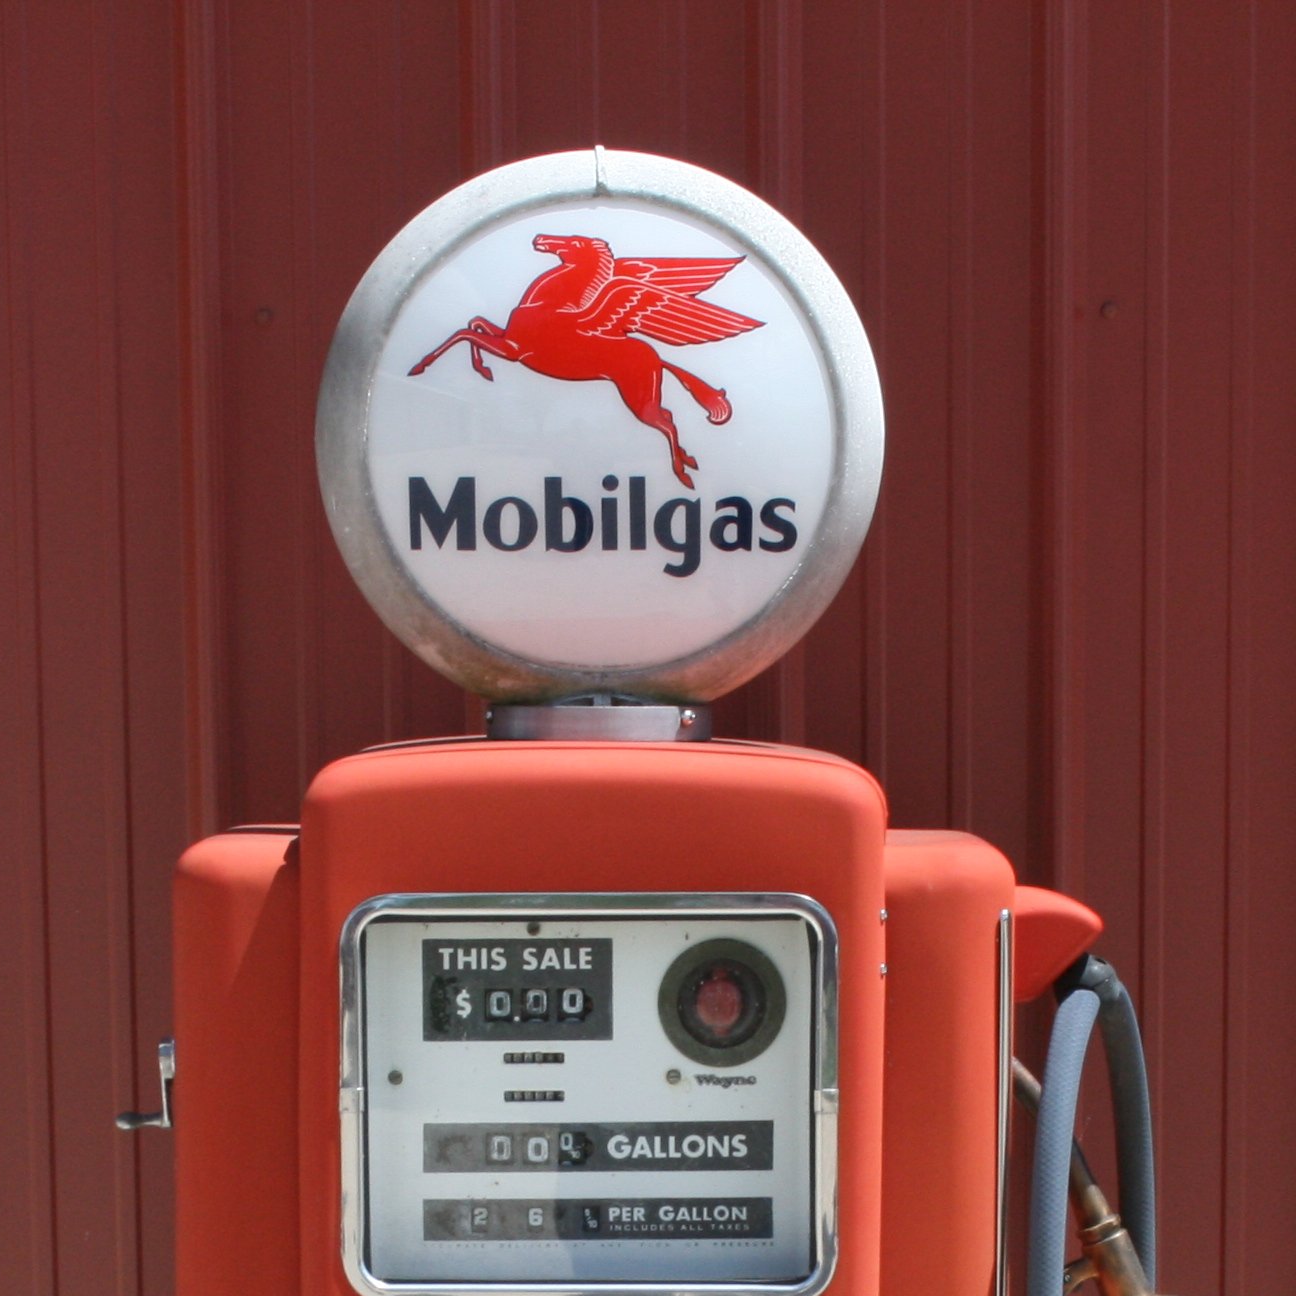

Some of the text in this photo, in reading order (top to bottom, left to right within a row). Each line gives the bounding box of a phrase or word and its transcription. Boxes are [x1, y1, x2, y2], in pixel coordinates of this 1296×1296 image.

[407, 474, 798, 577] Mobilgas
[439, 946, 593, 972] THIS SALE
[606, 1133, 749, 1160] GALLONS
[607, 1206, 646, 1222] PER
[657, 1204, 748, 1222] GALLON
[609, 1223, 751, 1232] INCLUDES ALL TAXES
